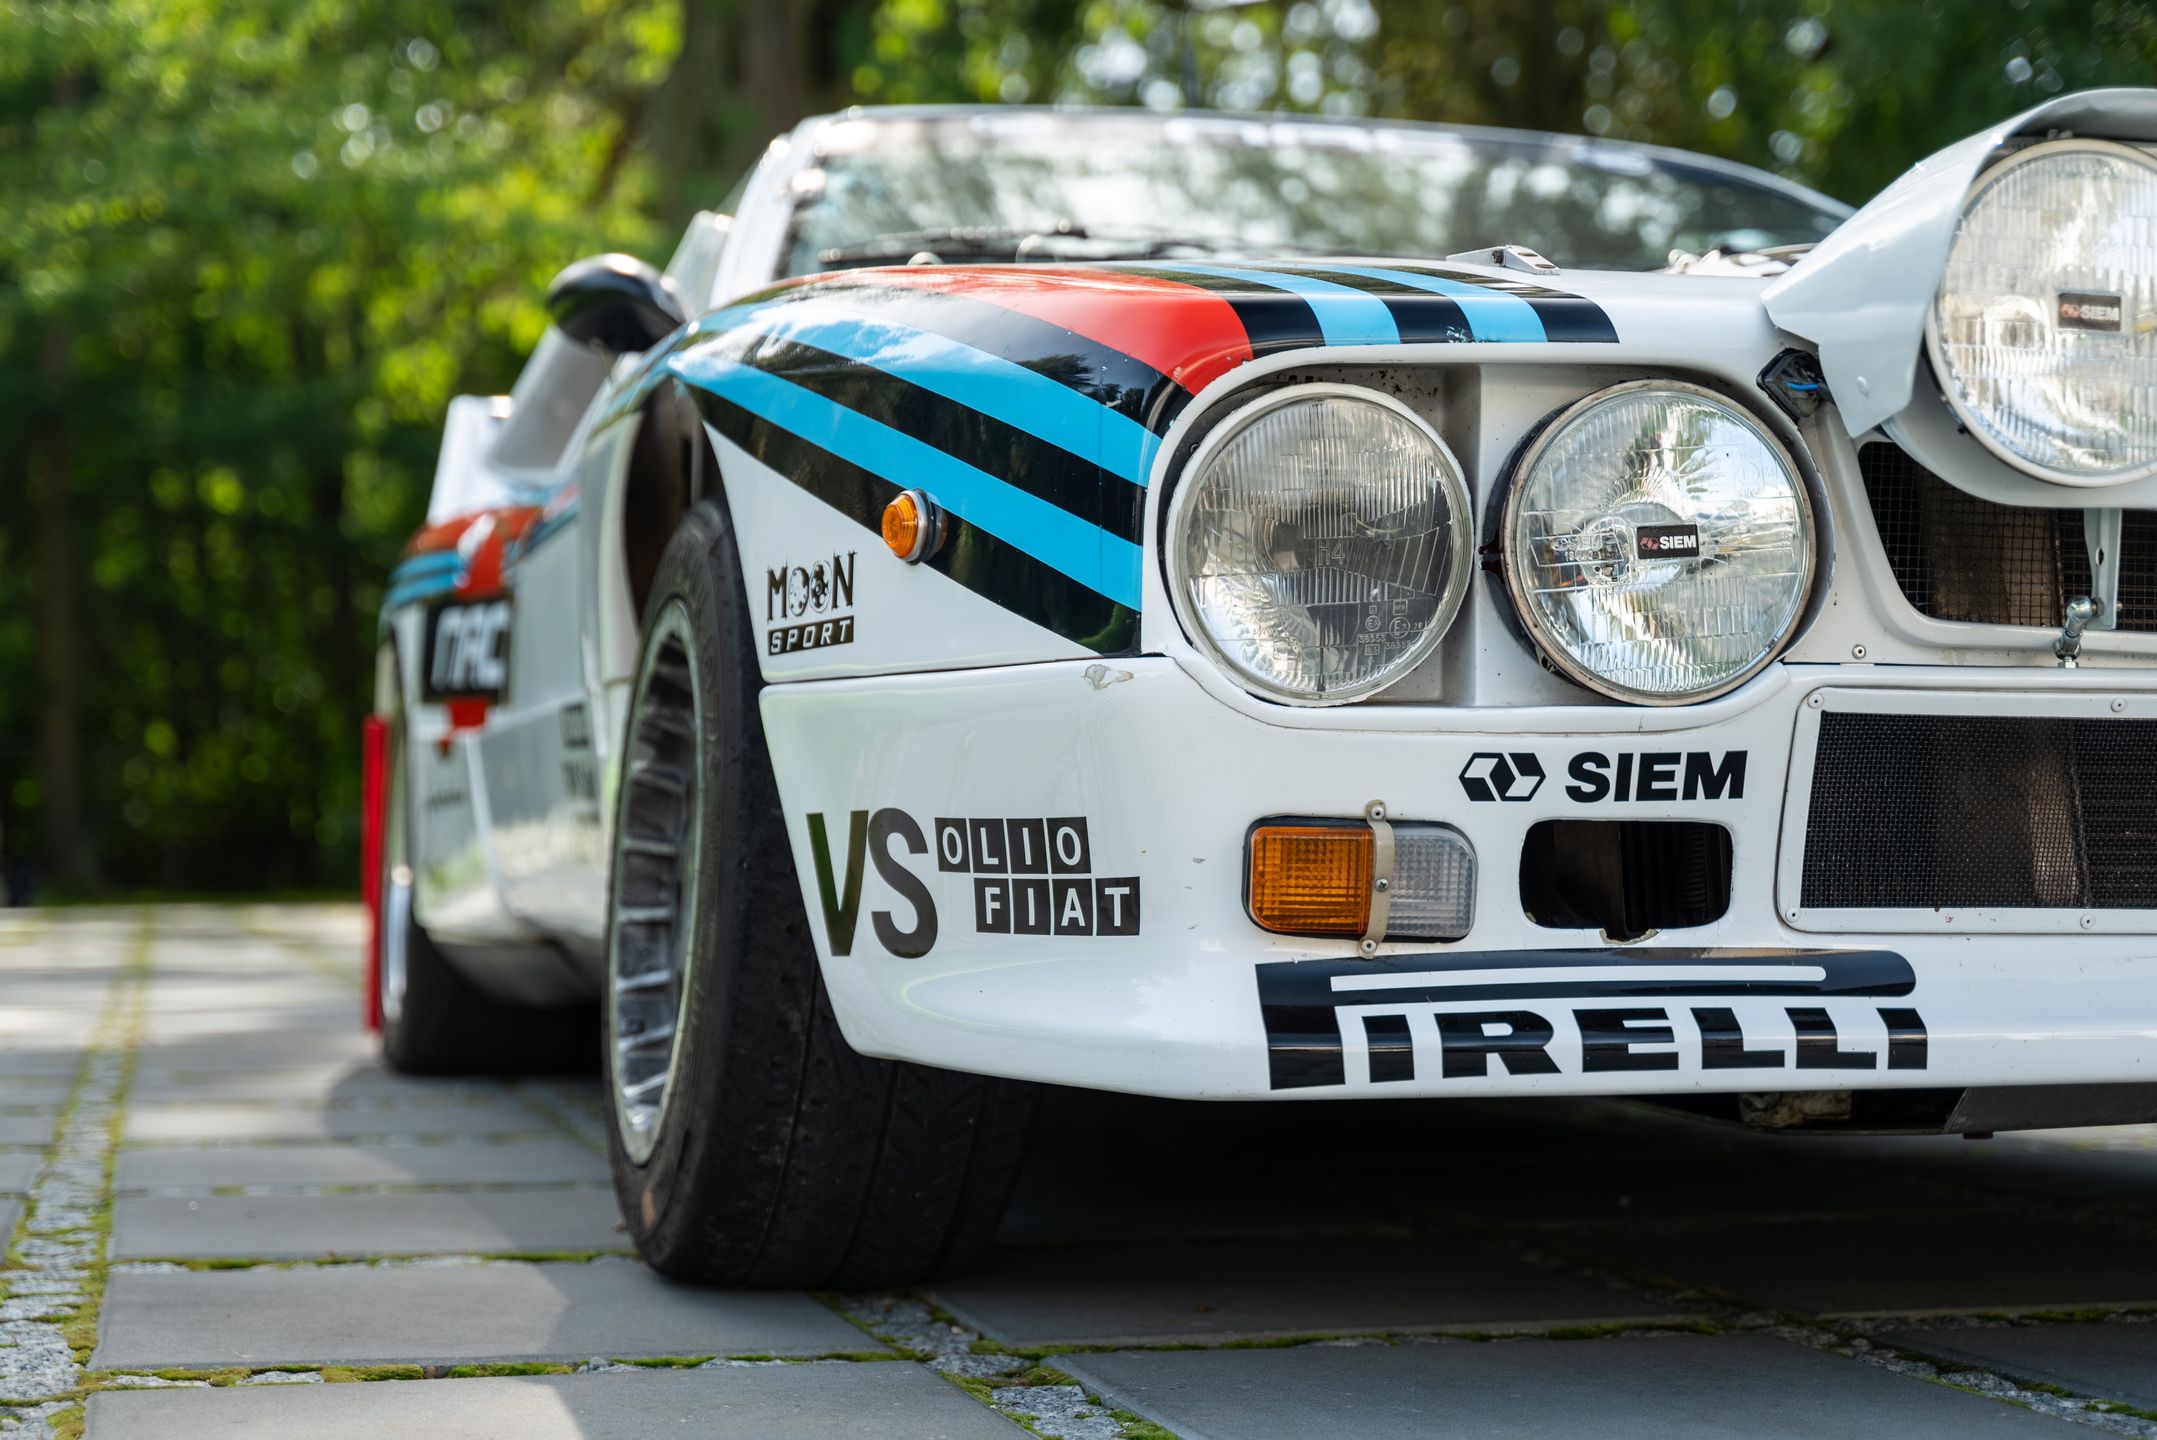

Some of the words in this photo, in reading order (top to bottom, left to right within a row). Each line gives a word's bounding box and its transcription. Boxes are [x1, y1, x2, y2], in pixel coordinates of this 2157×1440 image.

[1318, 539, 1346, 566] H4
[1659, 535, 1697, 550] SIEM
[766, 549, 857, 624] MOON
[770, 619, 851, 653] SPORT
[1566, 750, 1748, 803] SIEM
[942, 826, 1082, 866] OLIO
[806, 807, 939, 960] VS
[984, 887, 1130, 927] FIAT
[1256, 947, 1929, 1091] PIRELLI
